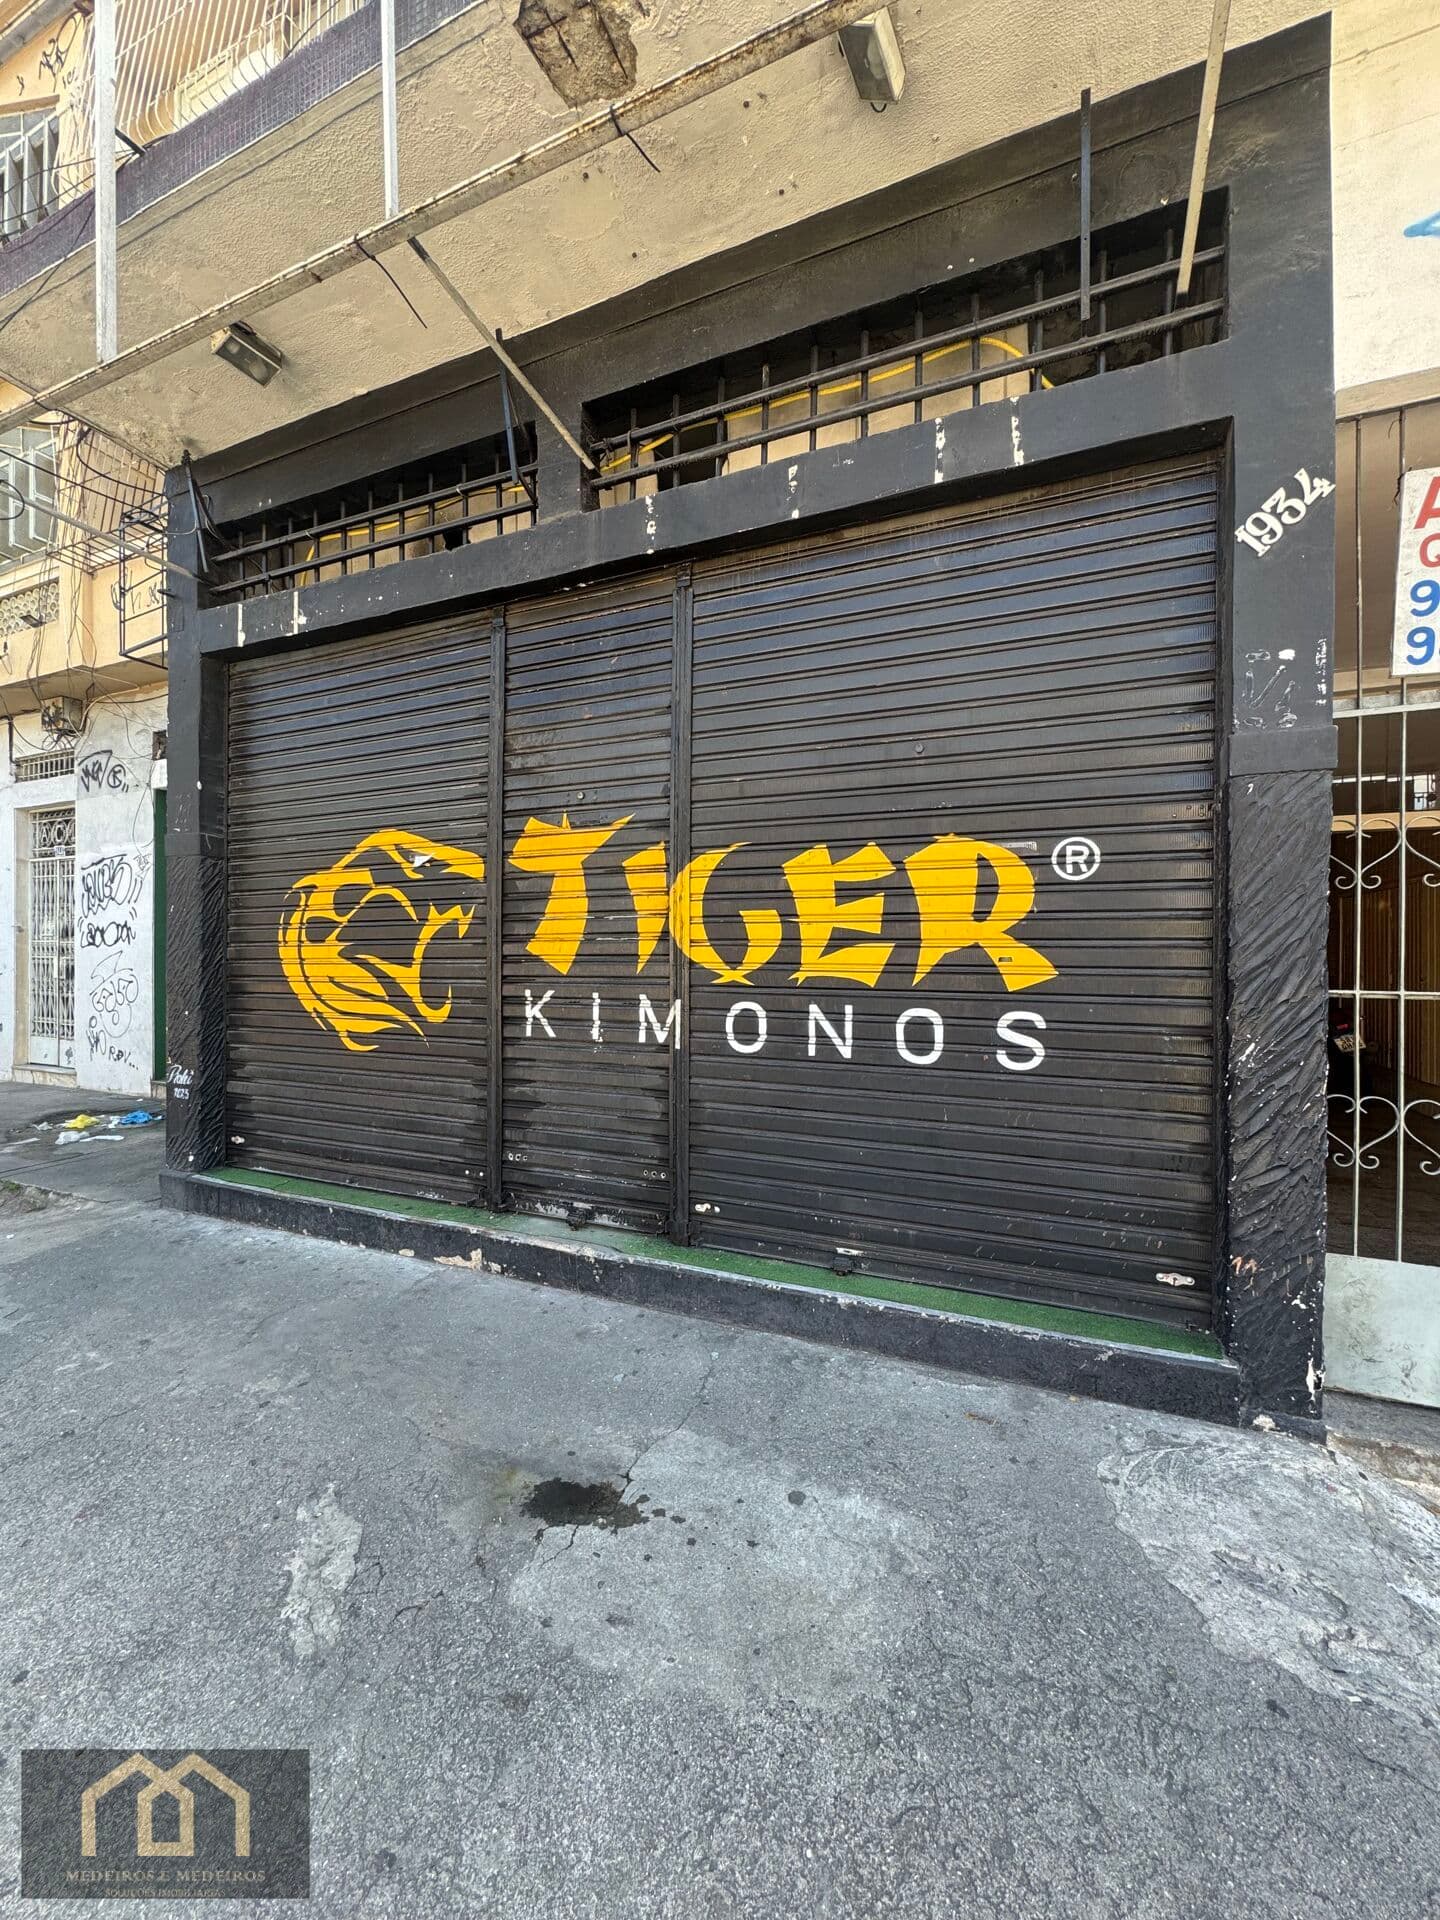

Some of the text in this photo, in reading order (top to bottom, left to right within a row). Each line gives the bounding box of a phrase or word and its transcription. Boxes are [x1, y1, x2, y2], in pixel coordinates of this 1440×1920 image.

[1234, 468, 1336, 557] 1934
[508, 810, 1059, 992] TIGER
[525, 989, 1047, 1071] KIMONOS
